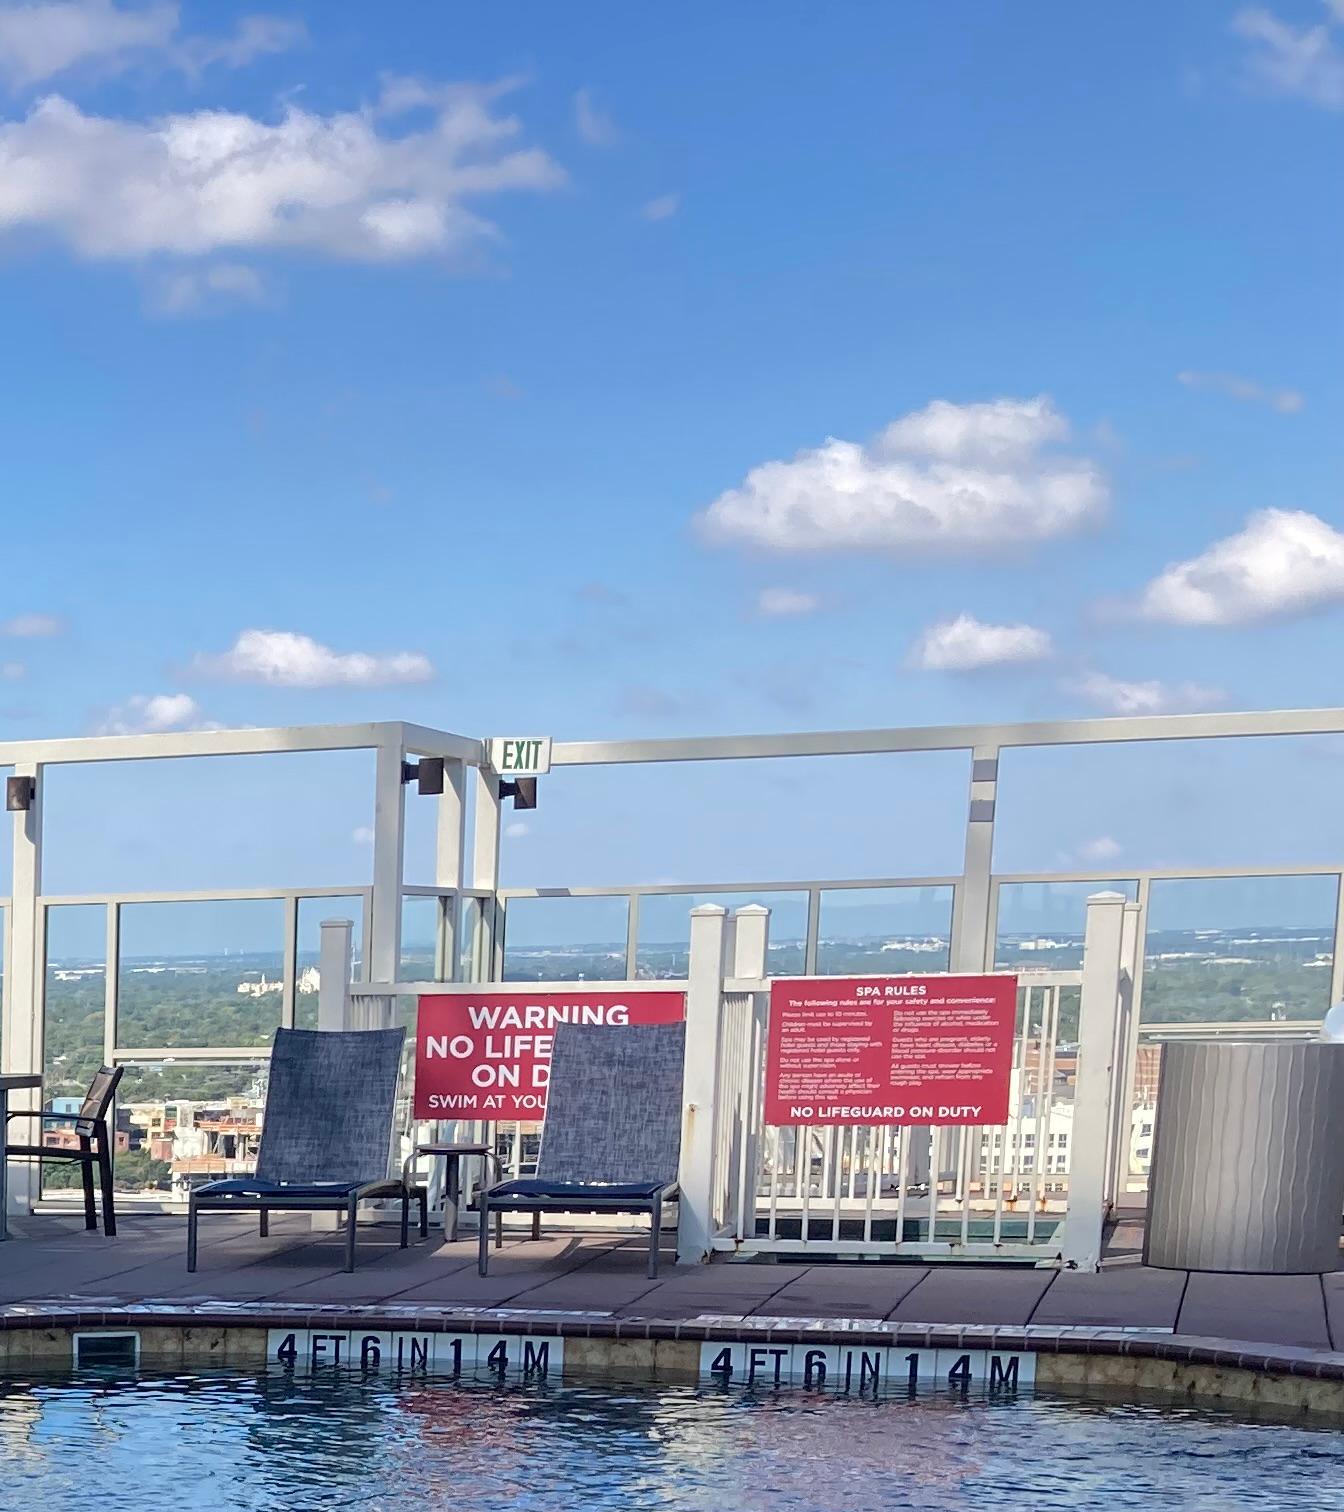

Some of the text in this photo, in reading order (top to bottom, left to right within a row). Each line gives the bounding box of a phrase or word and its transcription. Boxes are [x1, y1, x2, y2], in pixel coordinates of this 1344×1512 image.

[502, 740, 542, 770] EXIT
[856, 985, 927, 997] SPA RULES
[468, 1004, 630, 1030] WARNING
[426, 1035, 474, 1059] NO
[471, 1064, 520, 1088] ON
[428, 1094, 478, 1109] SWIM
[482, 1094, 507, 1109] AT
[790, 1105, 982, 1118] NO LIFEGUARD ON DUTY
[277, 1333, 550, 1375] 4 FT 6 IN 1 4 M
[711, 1347, 1020, 1391] 4 FT 6 IN 1 4 M
